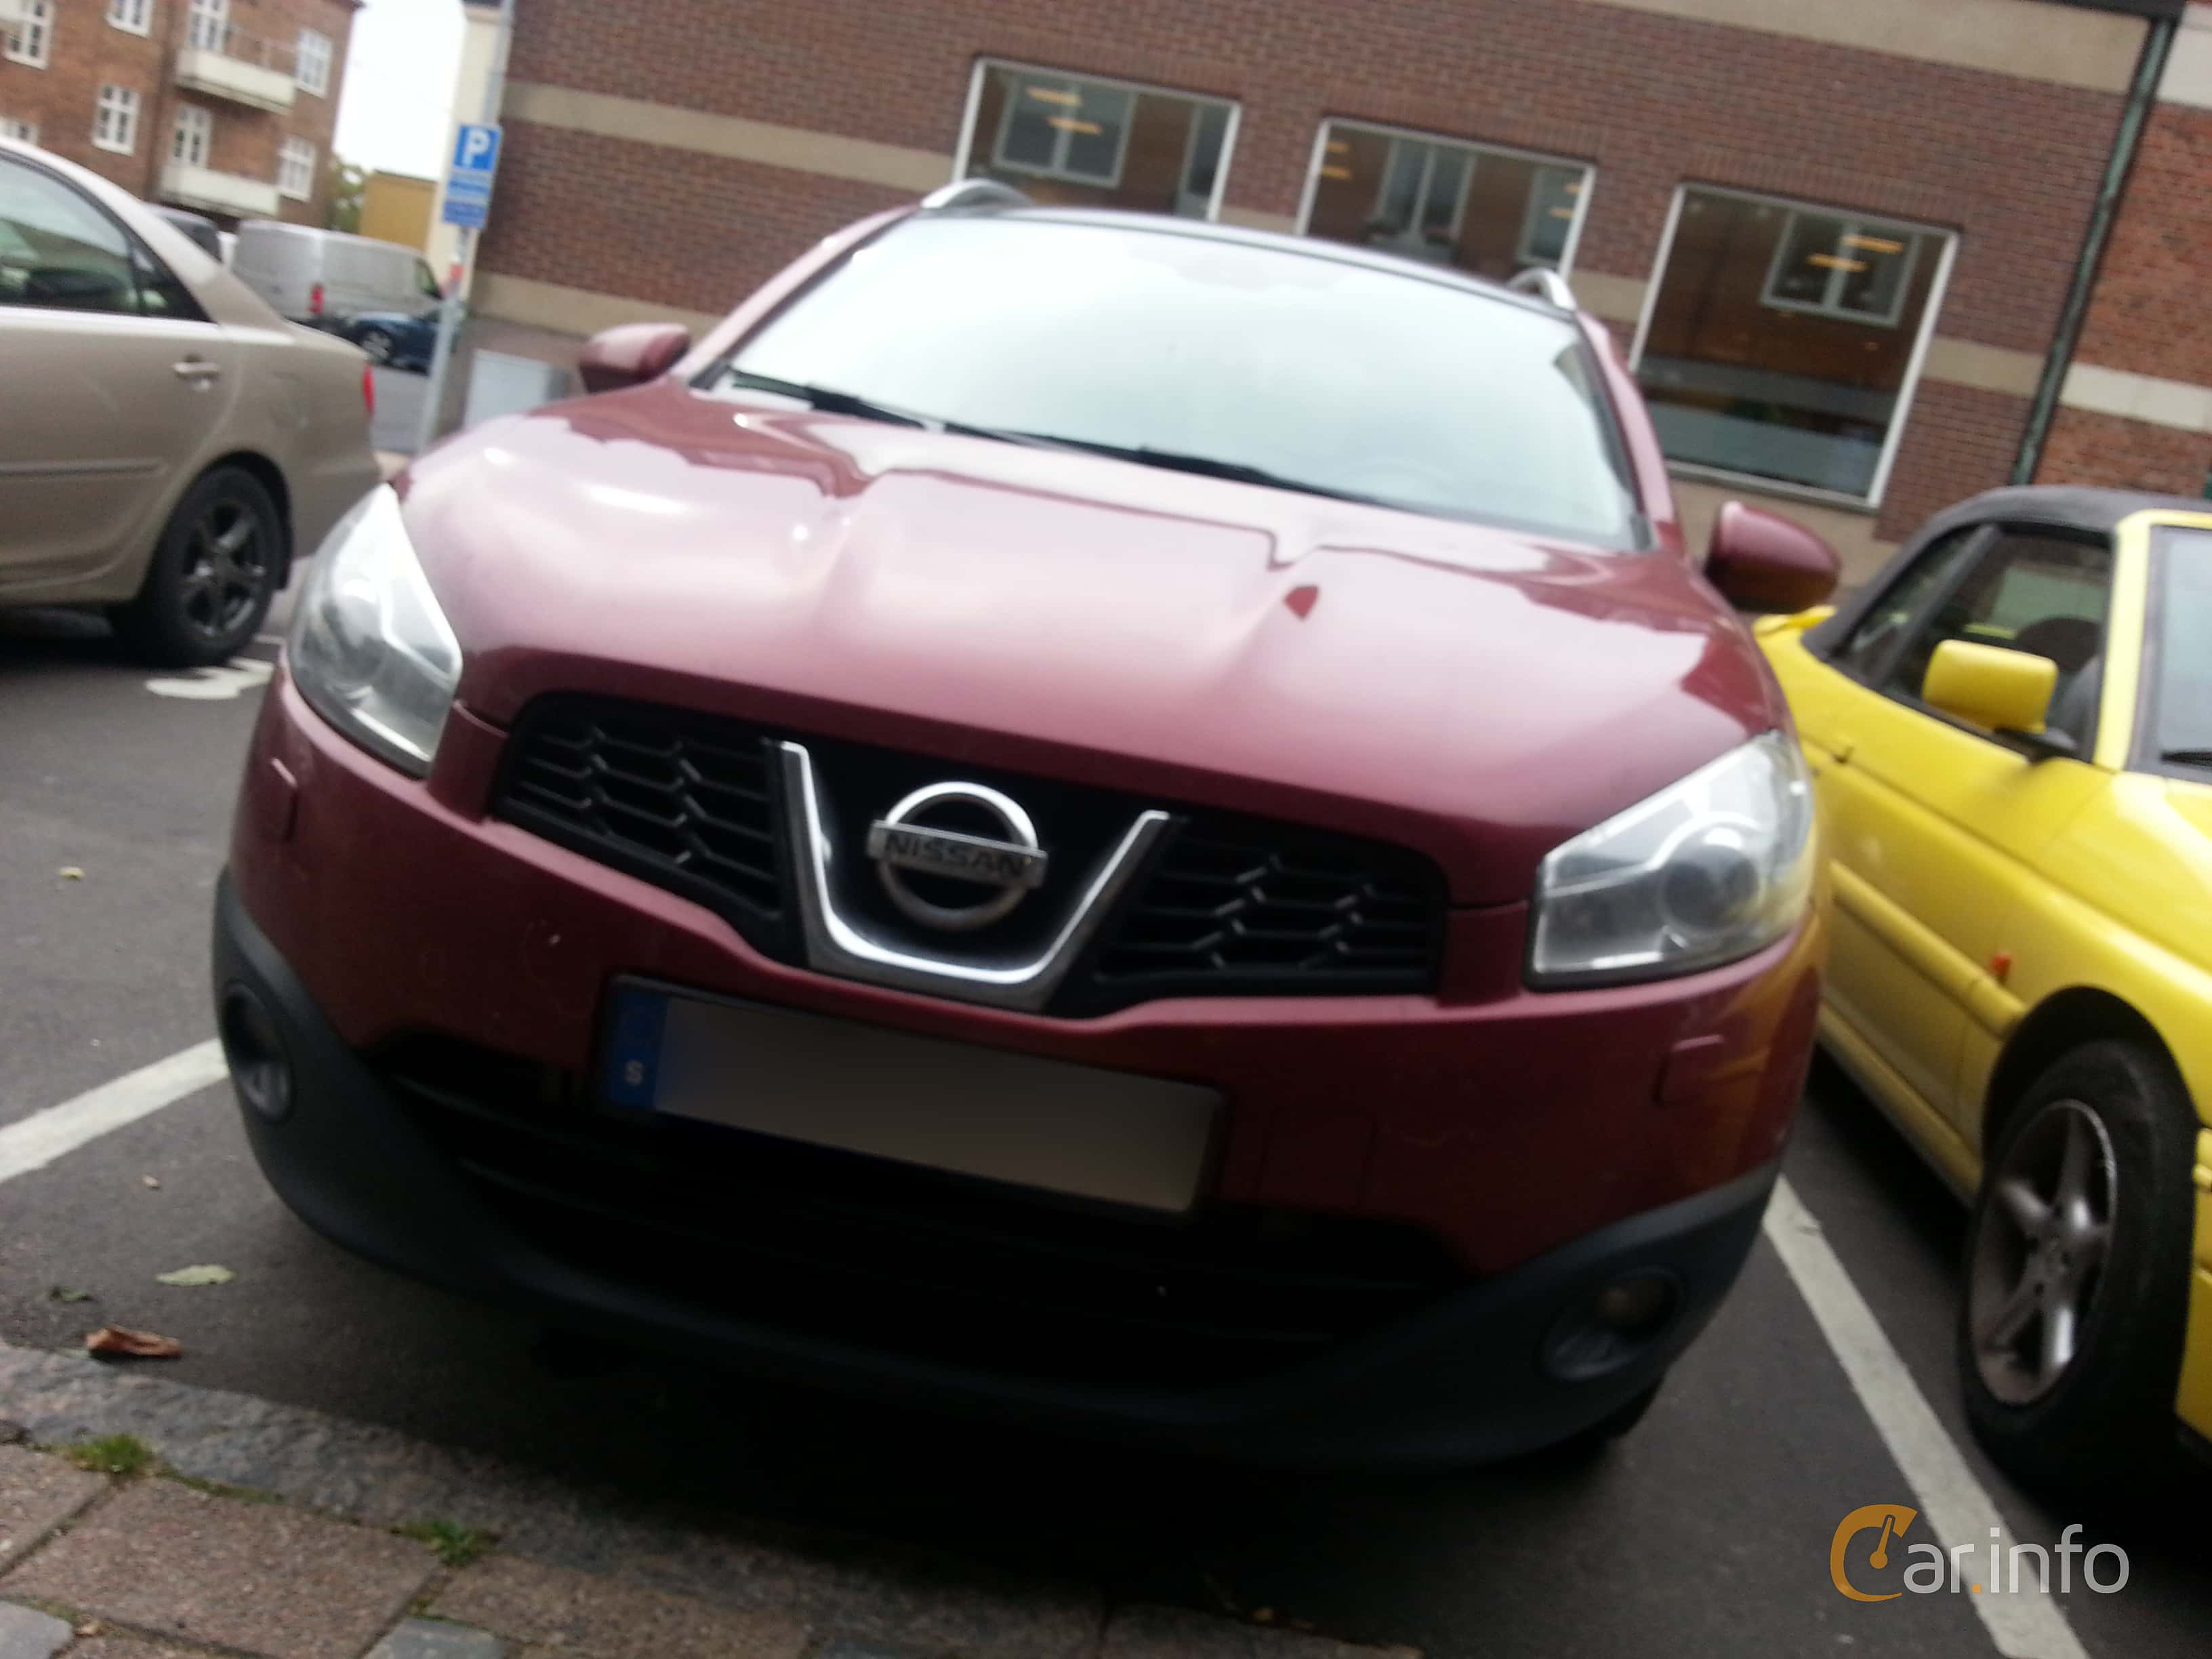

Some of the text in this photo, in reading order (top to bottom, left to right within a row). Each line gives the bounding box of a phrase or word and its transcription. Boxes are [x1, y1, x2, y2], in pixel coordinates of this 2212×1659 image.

[462, 127, 491, 168] P
[884, 832, 1024, 878] NISSAN
[625, 1059, 643, 1085] S
